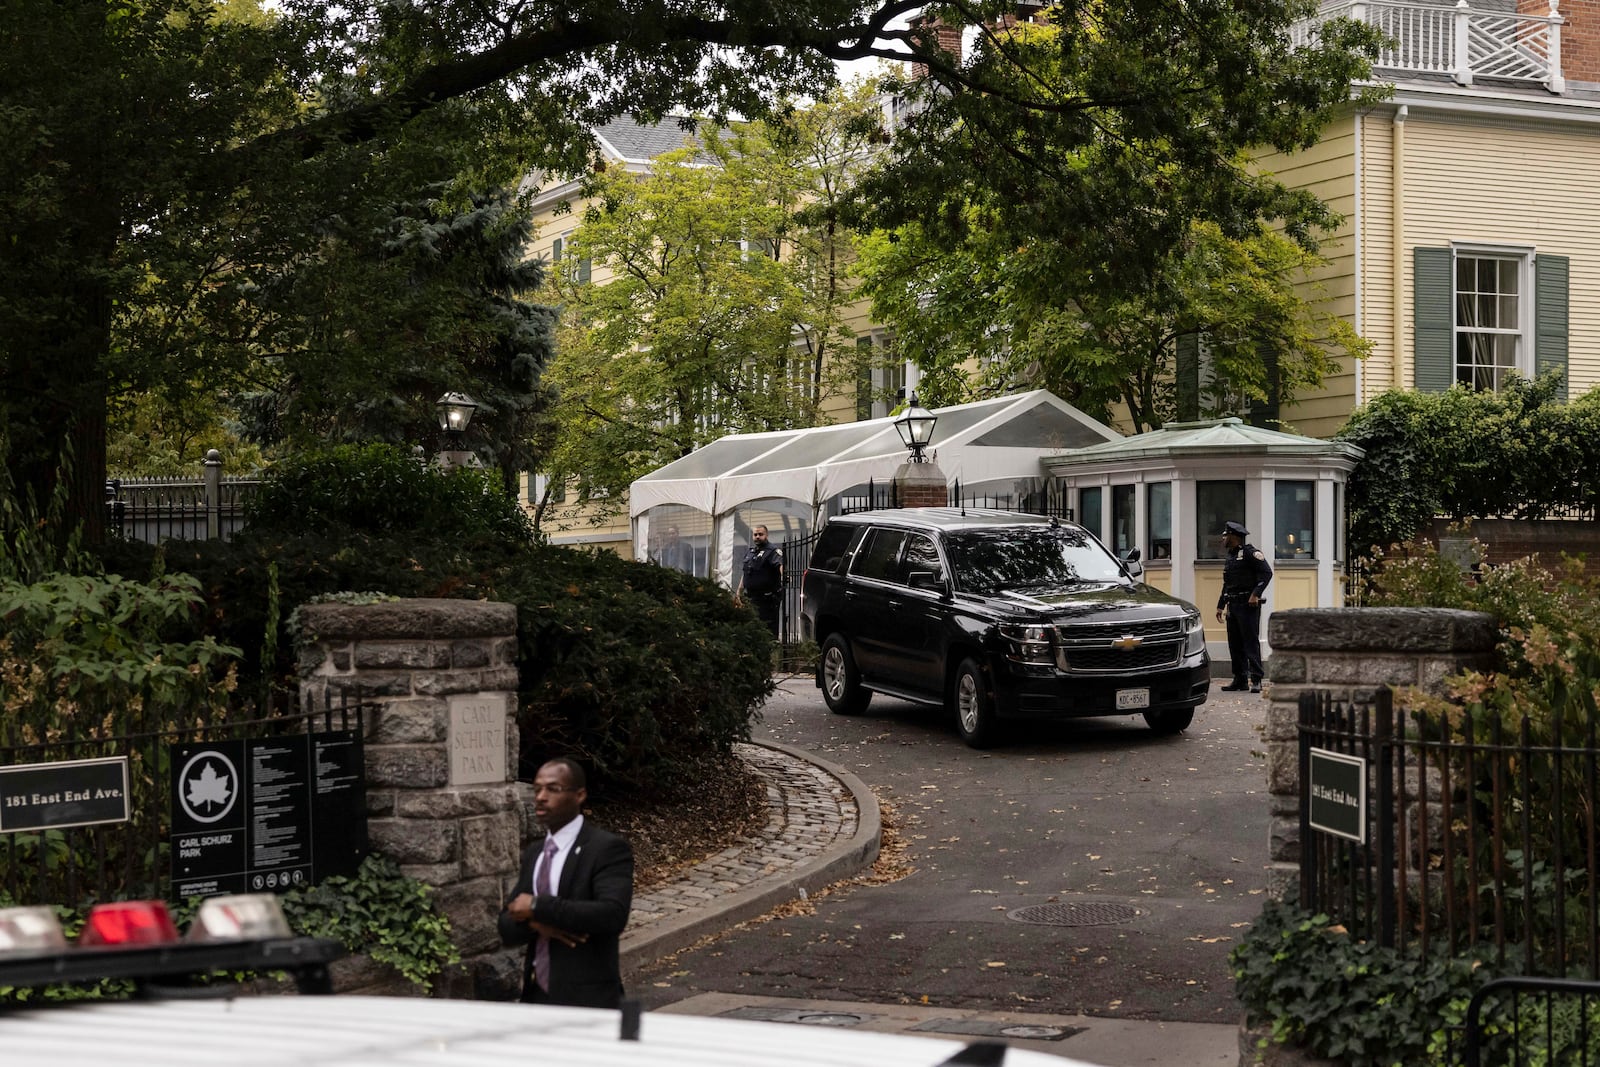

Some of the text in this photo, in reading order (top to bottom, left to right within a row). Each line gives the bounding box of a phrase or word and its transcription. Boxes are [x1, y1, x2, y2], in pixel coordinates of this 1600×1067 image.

[462, 706, 495, 724] CARL
[455, 730, 503, 749] SCHURZ
[462, 756, 495, 774] PARK
[5, 788, 123, 808] 181 East End Ave.
[1333, 788, 1344, 804] End
[180, 834, 232, 848] CARL SCHURZ
[180, 848, 201, 858] PARK
